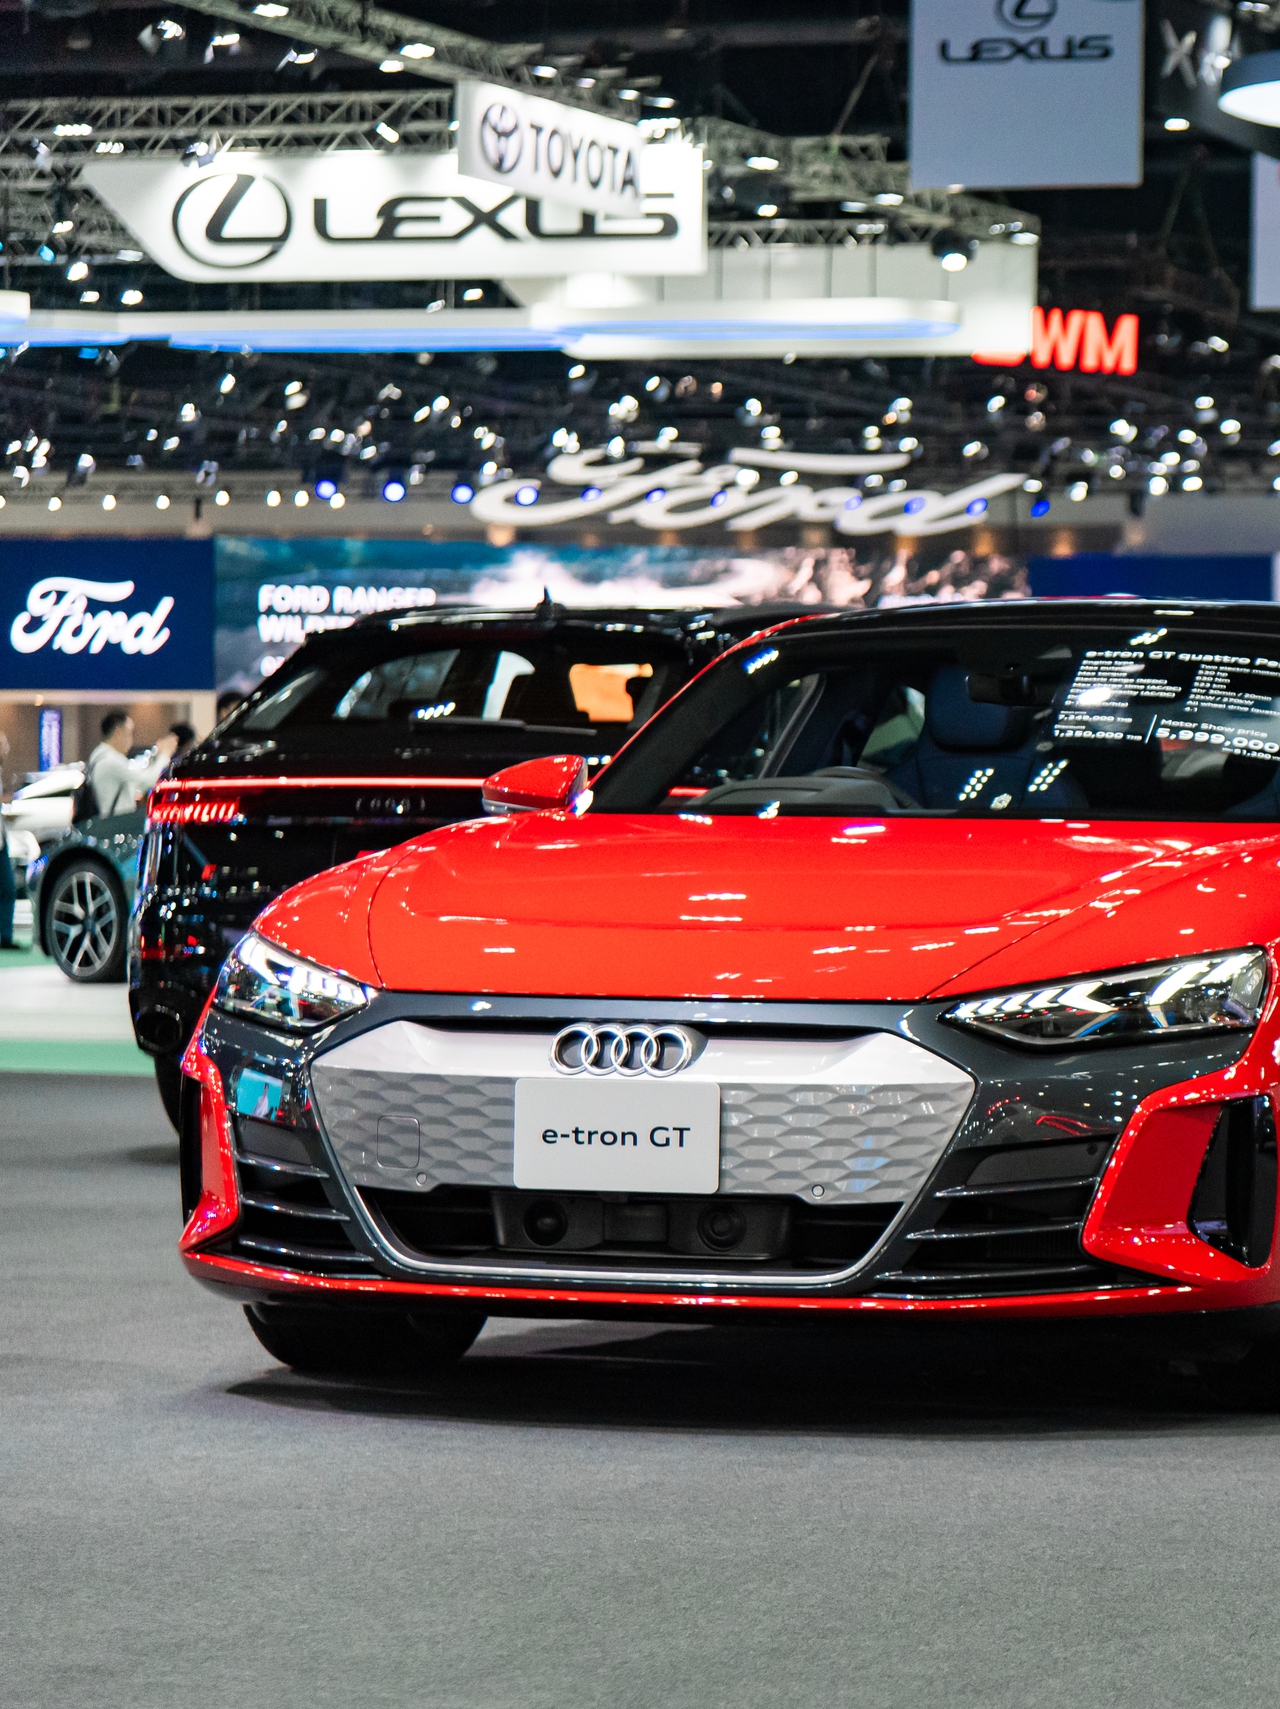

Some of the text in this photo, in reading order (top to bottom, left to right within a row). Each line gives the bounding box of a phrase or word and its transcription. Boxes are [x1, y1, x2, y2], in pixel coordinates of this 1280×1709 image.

[939, 35, 1114, 63] LEXUS
[529, 121, 639, 198] TOYOTA
[971, 305, 1139, 376] WM
[470, 441, 1028, 537] Ford
[258, 584, 437, 614] FORD RANGER
[9, 576, 175, 655] Ford
[1085, 650, 1144, 659] e-tron
[1148, 650, 1176, 660] GT
[1178, 653, 1251, 665] quattro
[1200, 701, 1226, 709] wheel
[1227, 704, 1249, 712] drive
[1155, 727, 1280, 753] 5,999,000
[1161, 719, 1268, 738] Motor Show price
[541, 1126, 690, 1148] e-tron GT
